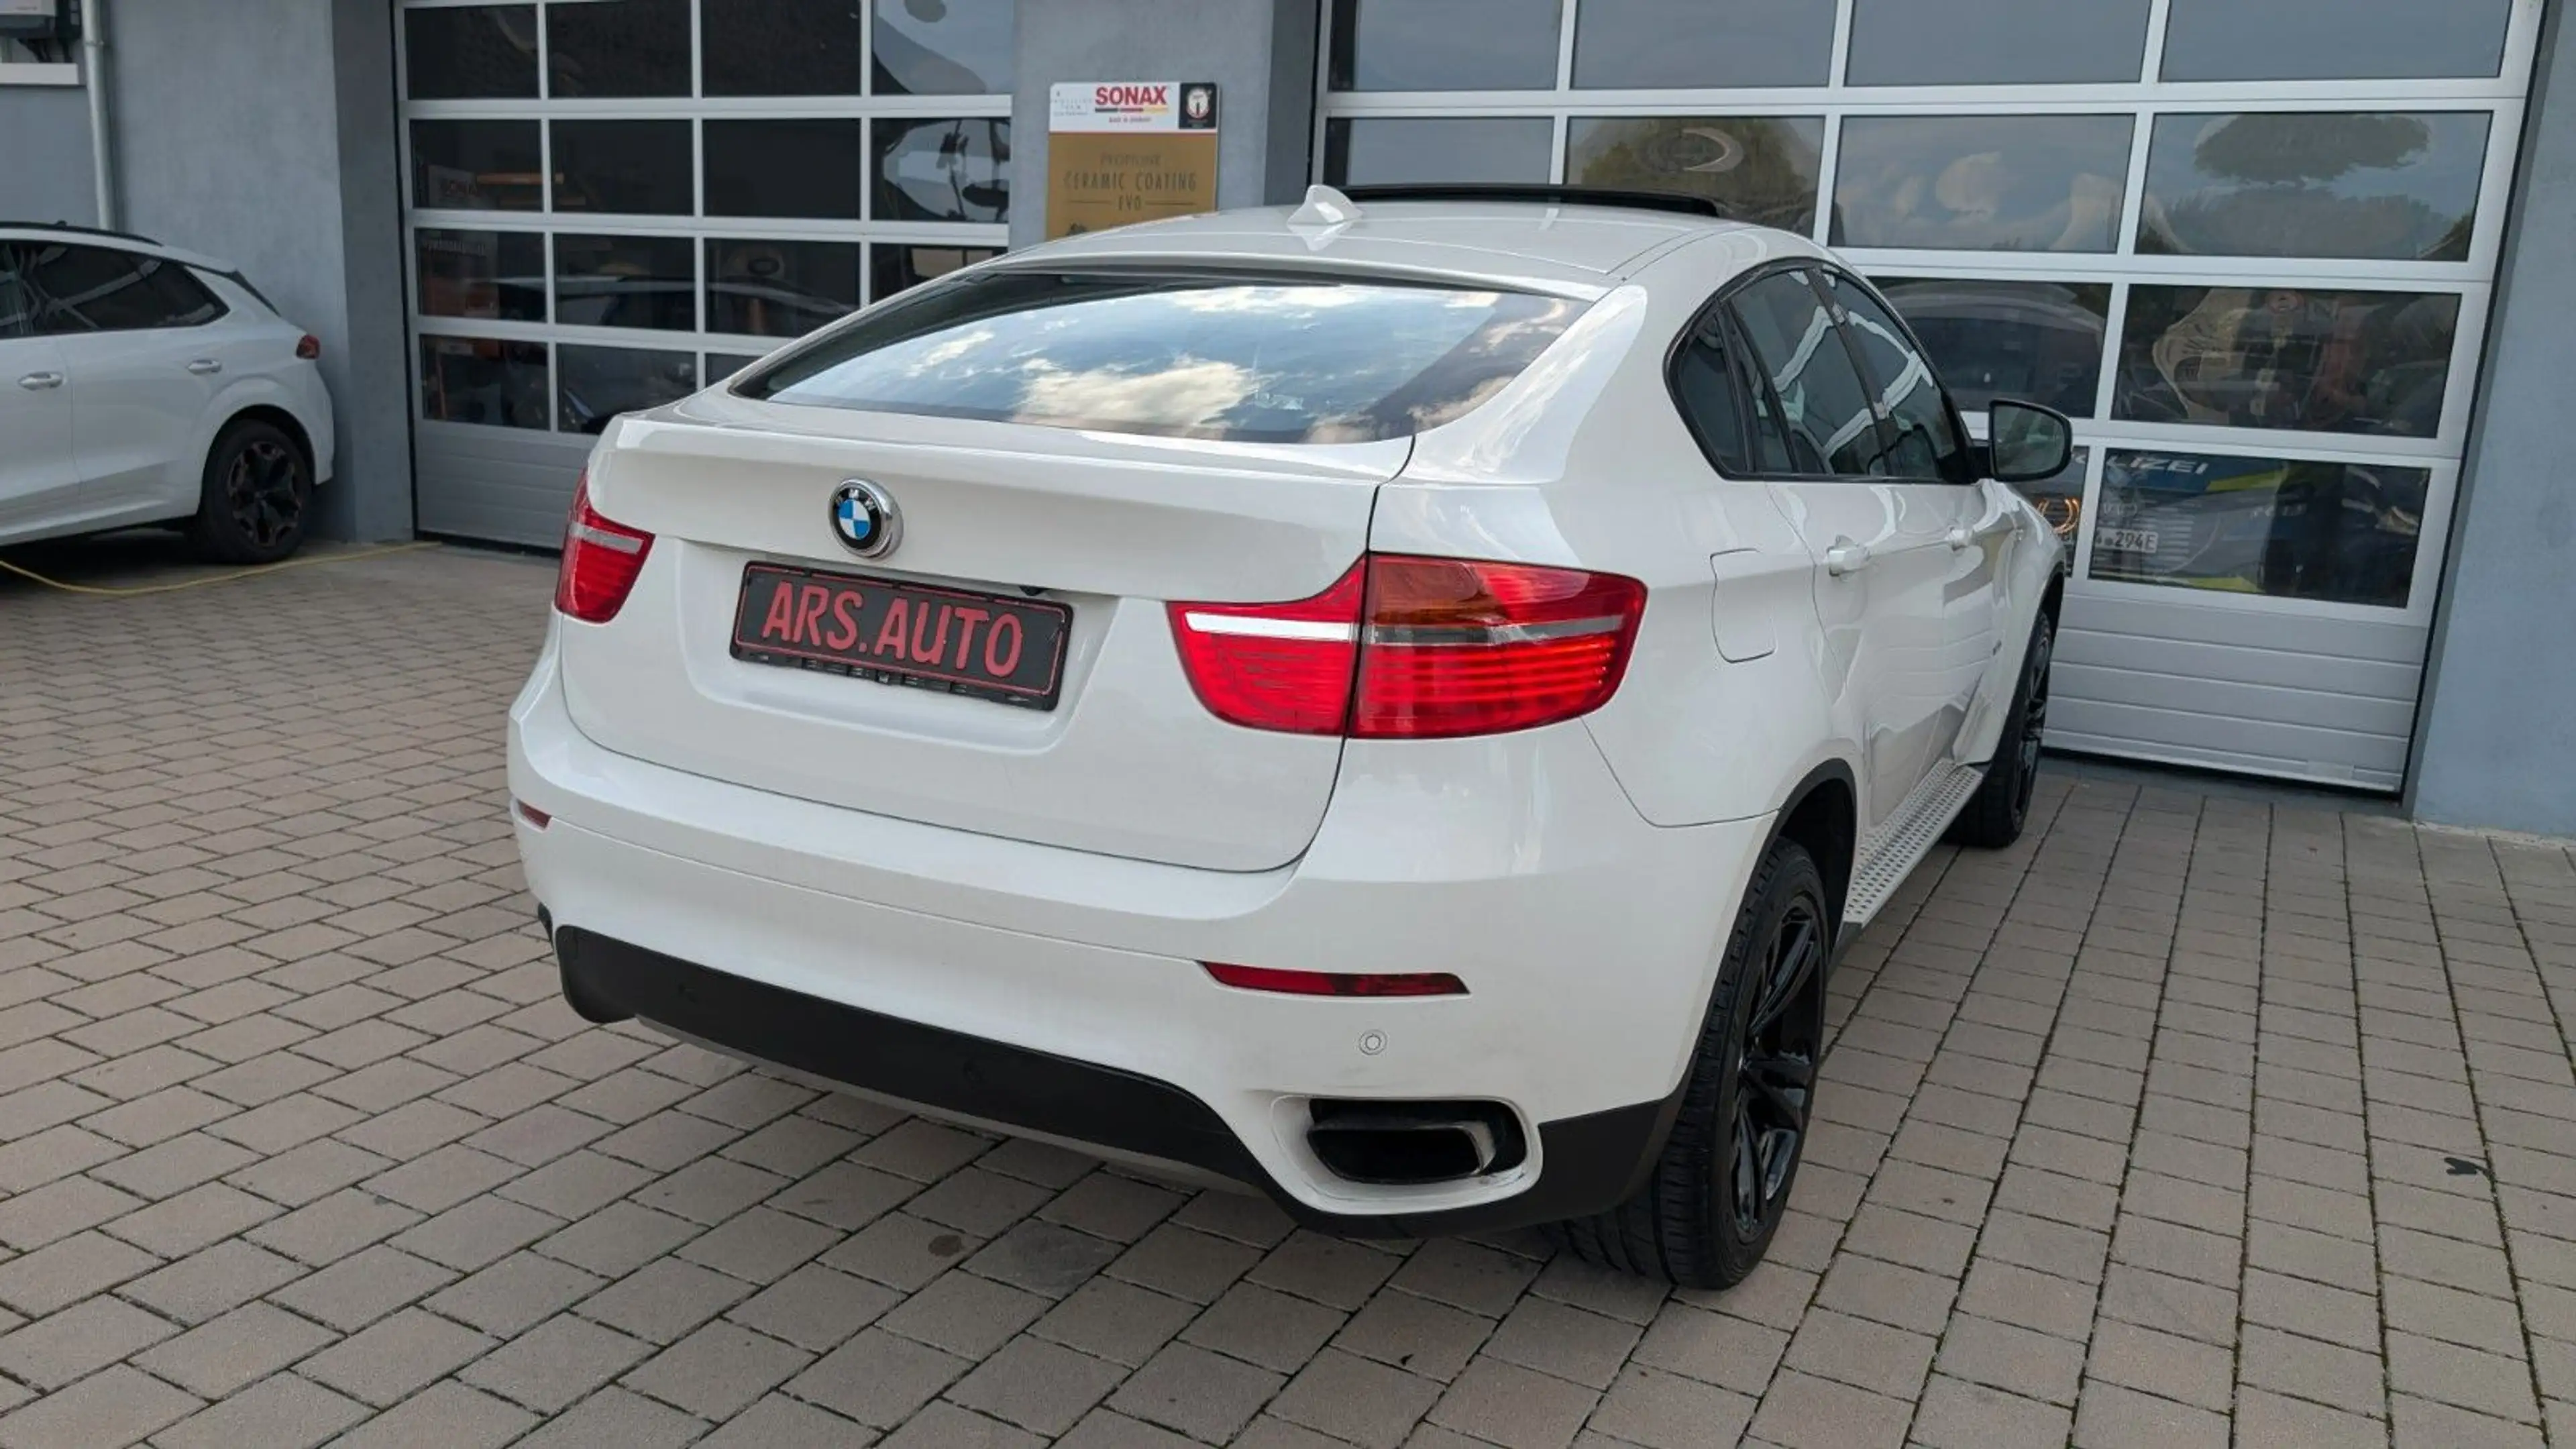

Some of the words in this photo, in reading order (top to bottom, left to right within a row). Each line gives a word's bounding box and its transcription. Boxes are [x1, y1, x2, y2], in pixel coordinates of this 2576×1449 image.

[1095, 86, 1167, 106] SONAX
[1063, 170, 1126, 191] CERAMIC
[1136, 170, 1197, 192] COATING
[1118, 195, 1142, 211] EVO
[762, 580, 1024, 678] ARS.AUTO
